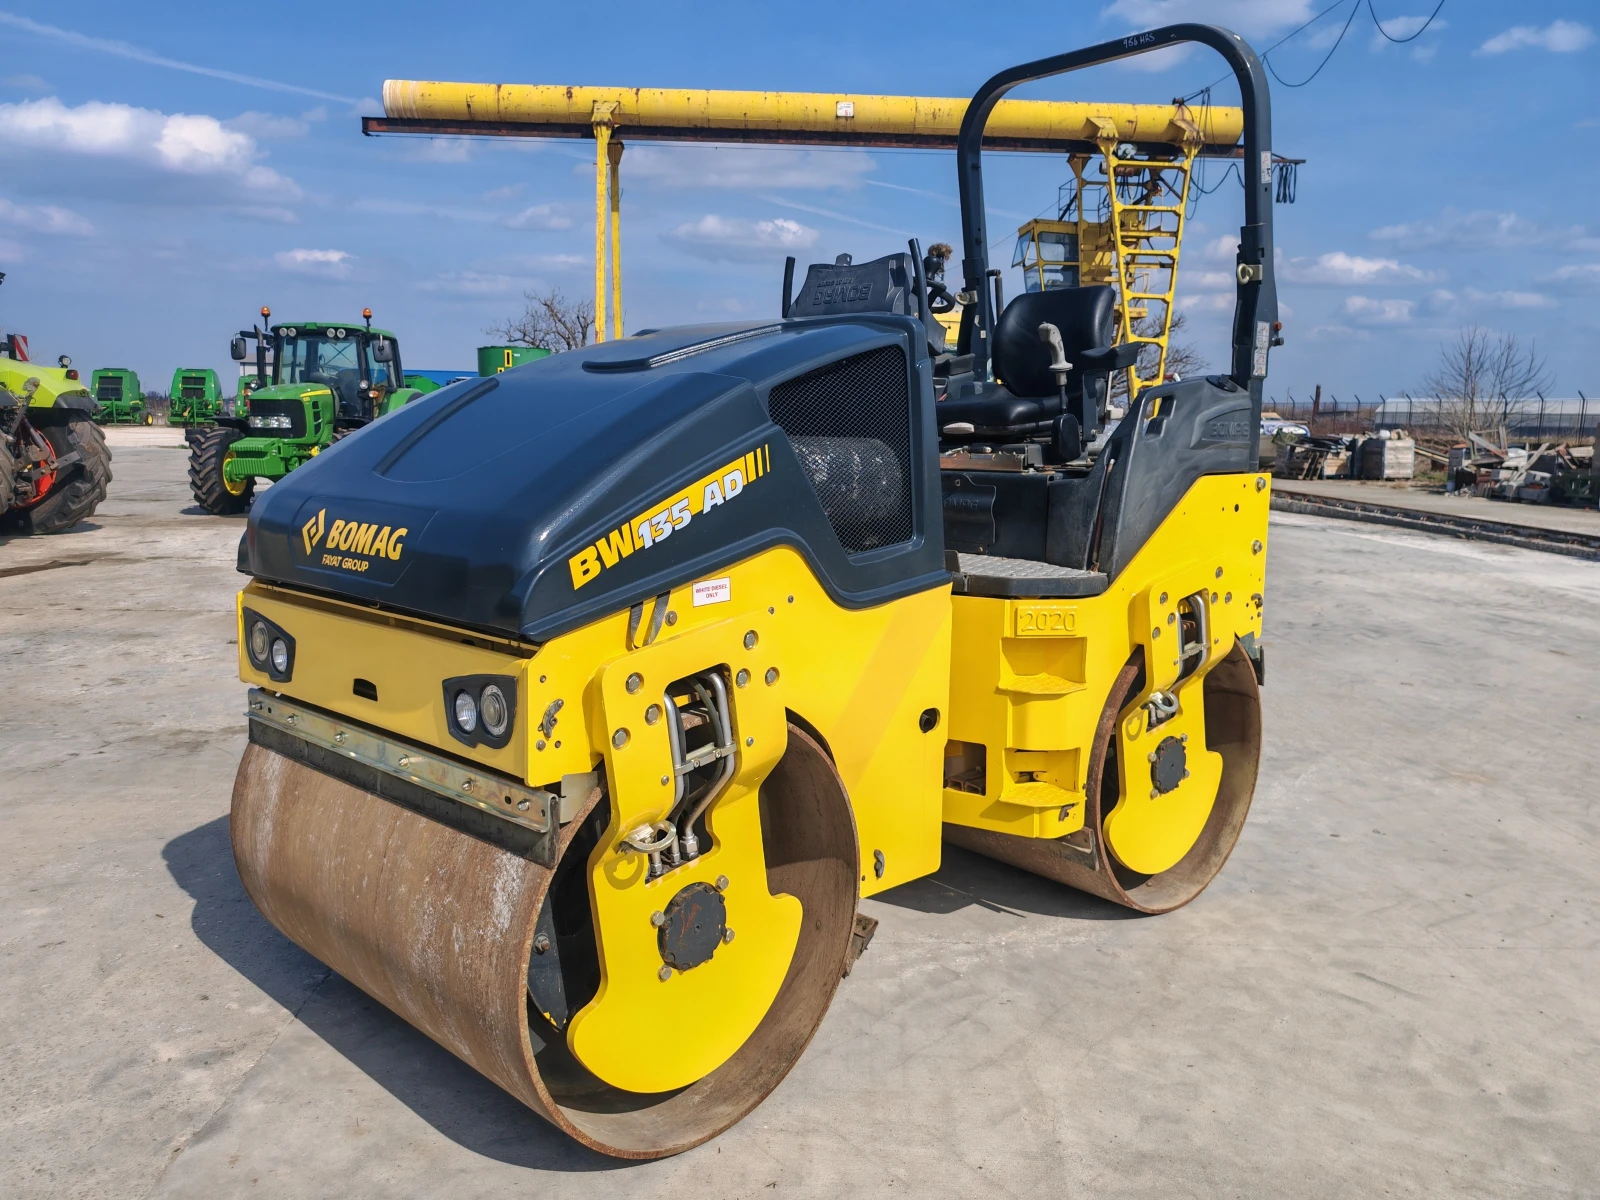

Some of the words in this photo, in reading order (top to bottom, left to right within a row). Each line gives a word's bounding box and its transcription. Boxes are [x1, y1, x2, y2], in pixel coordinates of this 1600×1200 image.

[1140, 33, 1155, 44] HRS
[812, 283, 873, 306] BOMAG
[943, 497, 979, 511] OMAG
[568, 521, 634, 590] BW
[637, 496, 692, 550] 135
[702, 468, 744, 514] AD
[326, 519, 408, 560] BOMAG
[321, 554, 343, 568] FAYAT
[341, 557, 369, 572] GROUP
[695, 586, 711, 594] WHITE
[711, 583, 729, 592] DIESEL
[705, 591, 719, 599] ONLY
[1019, 610, 1077, 633] 2020
